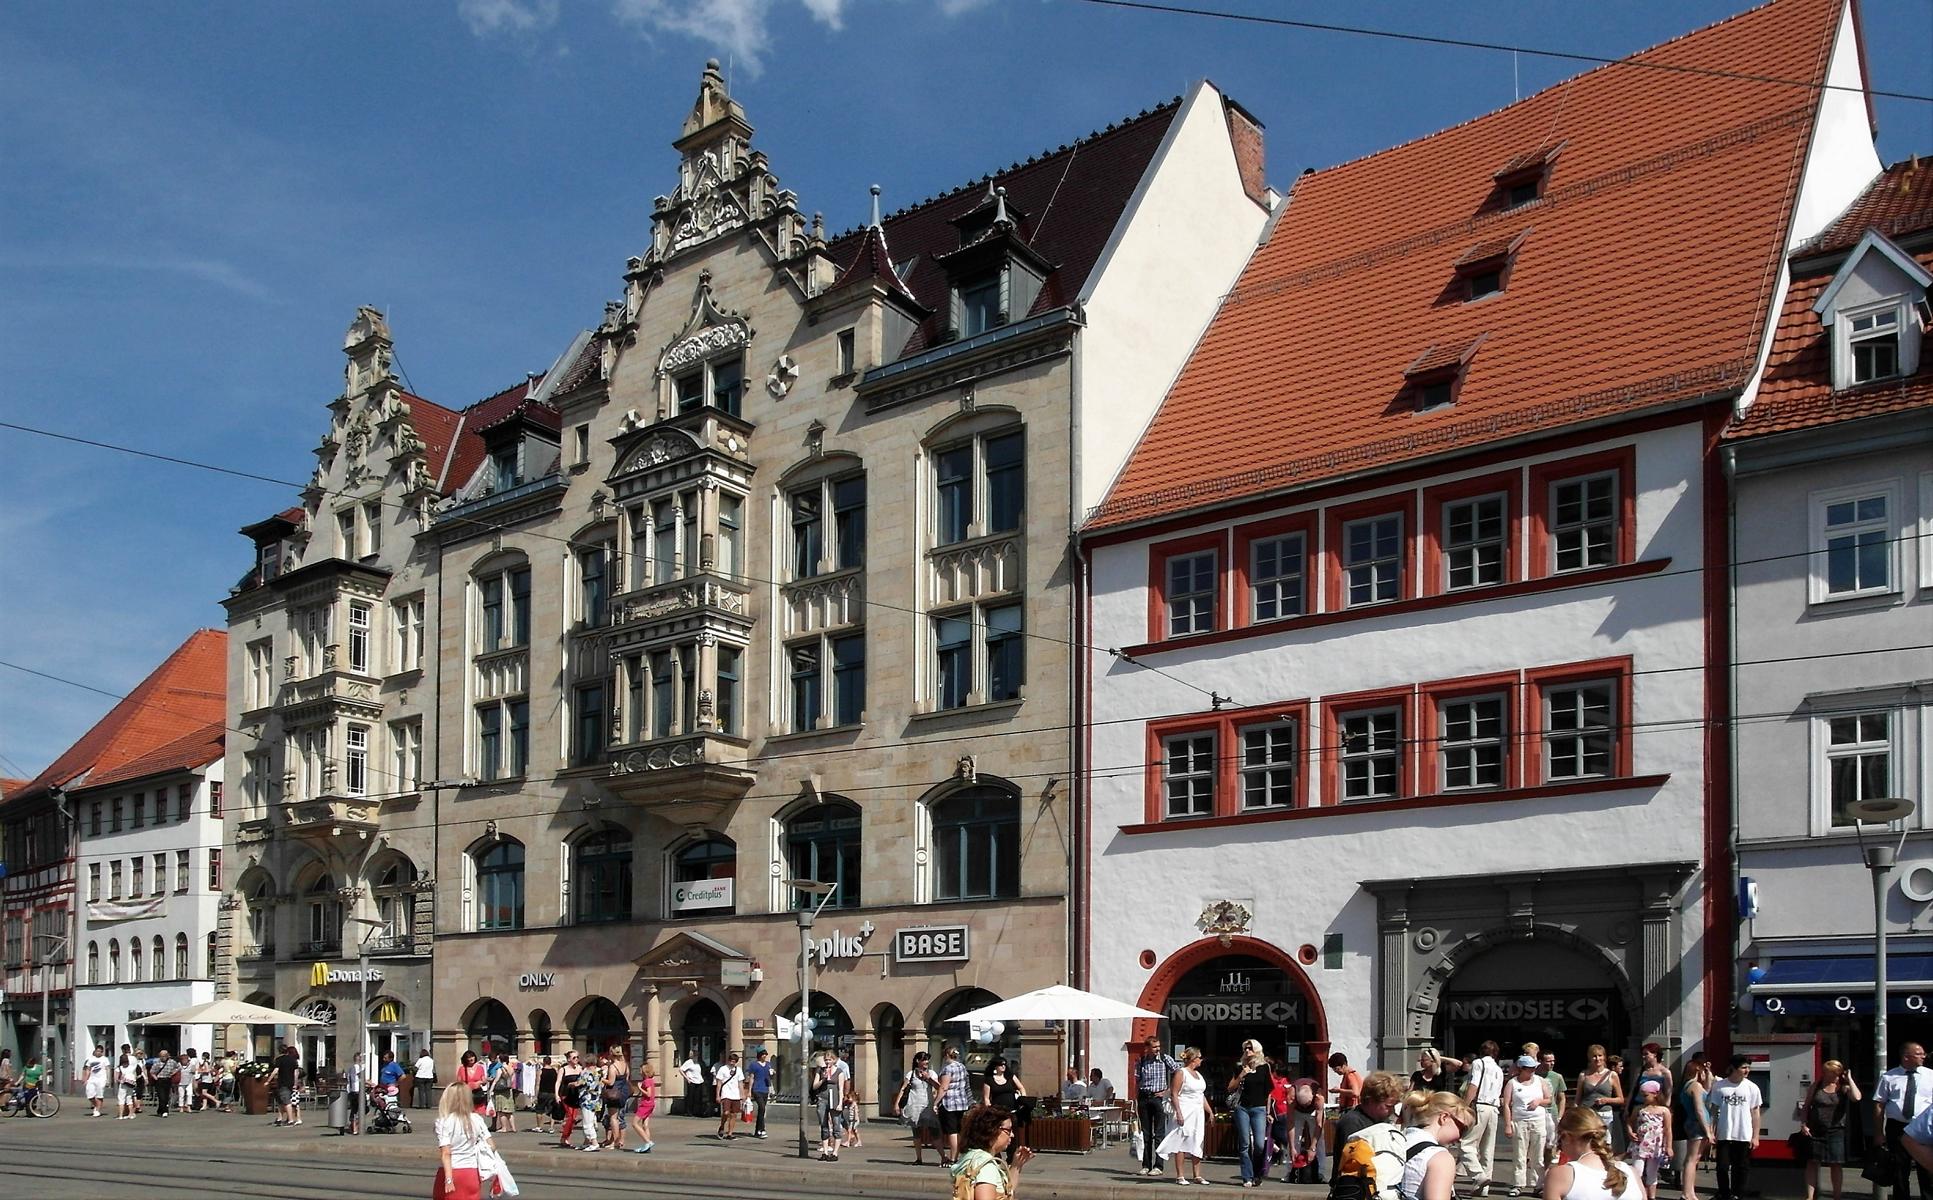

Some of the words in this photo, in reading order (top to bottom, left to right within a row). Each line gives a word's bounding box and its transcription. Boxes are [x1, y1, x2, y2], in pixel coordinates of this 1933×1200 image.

[687, 890, 722, 901] Creditplus
[904, 933, 960, 955] BASE
[310, 962, 383, 987] McDonad's
[1171, 1003, 1262, 1020] NORDSEE
[1452, 1001, 1565, 1020] NORDSEE
